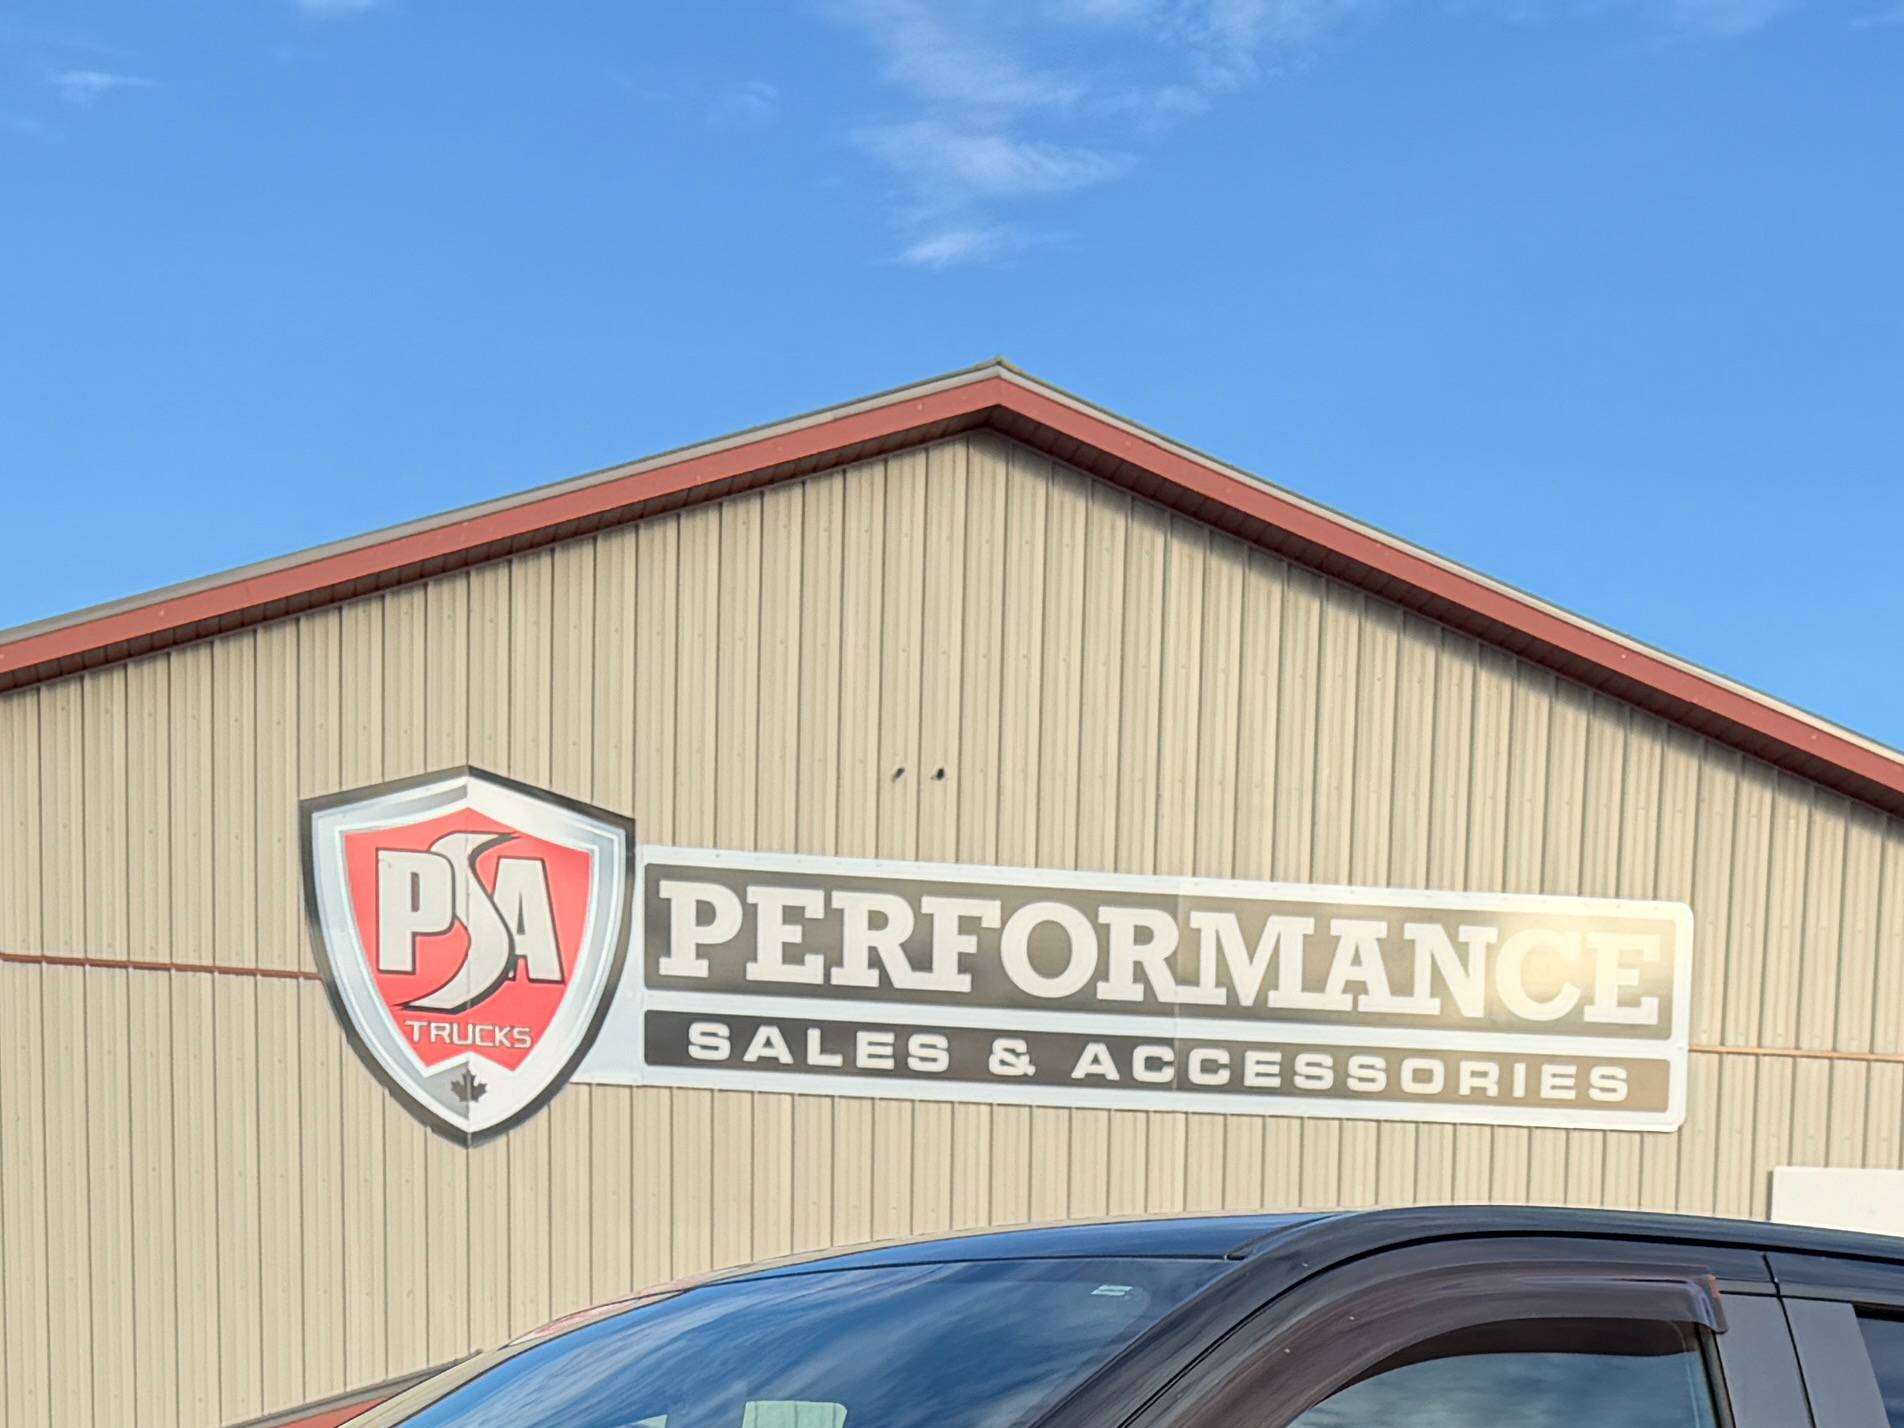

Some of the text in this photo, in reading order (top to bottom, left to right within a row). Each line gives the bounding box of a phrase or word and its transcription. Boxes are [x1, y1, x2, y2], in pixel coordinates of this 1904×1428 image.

[376, 831, 565, 1014] PSA
[659, 879, 1661, 1025] PERFORMANCE
[405, 1020, 533, 1049] TRUCKS
[688, 1021, 1628, 1102] SALES & ACCESSORIES
